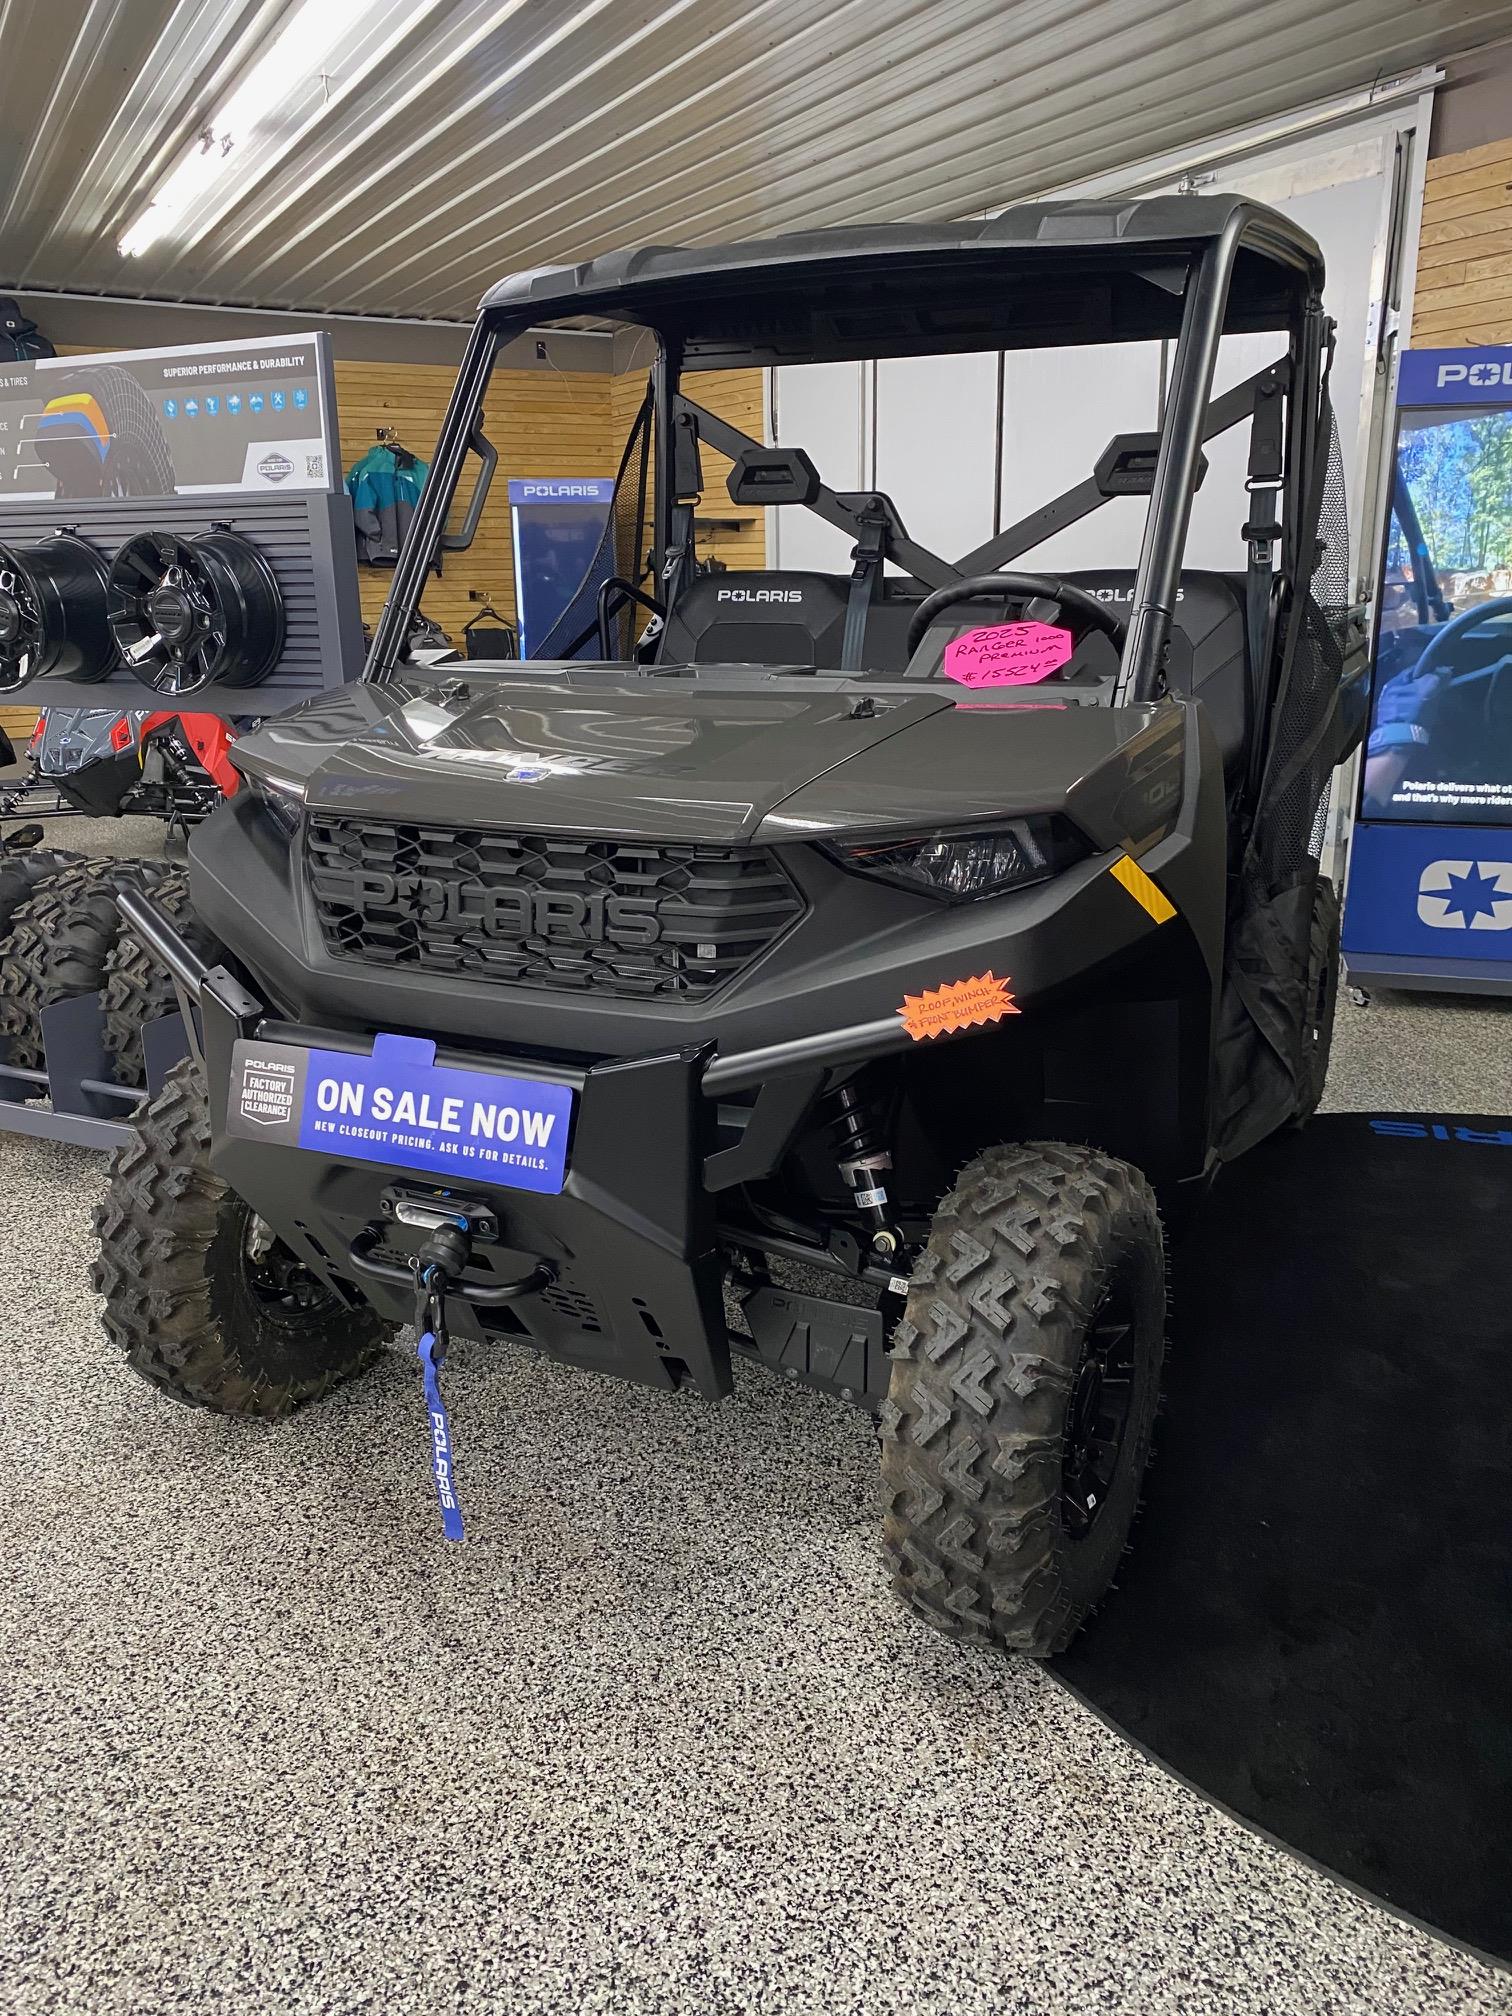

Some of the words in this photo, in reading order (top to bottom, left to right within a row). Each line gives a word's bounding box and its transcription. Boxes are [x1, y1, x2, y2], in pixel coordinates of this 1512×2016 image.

[163, 365, 198, 377] SUPERIOR
[199, 361, 252, 374] PERFORMANCE
[253, 361, 259, 370] &
[260, 356, 305, 369] DURABILITY
[10, 376, 28, 386] TIRES
[523, 485, 600, 497] POLARIS
[717, 589, 803, 603] POLARIS
[972, 624, 1037, 642] 2025
[955, 639, 1028, 657] RANGER
[979, 644, 1063, 663] PREMIUM
[1402, 780, 1436, 791] Polaris
[1436, 781, 1475, 792] delivers
[1475, 783, 1501, 793] what
[1392, 793, 1411, 802] and
[1412, 793, 1439, 803] that's
[1439, 794, 1460, 806] why
[1460, 796, 1486, 804] more
[353, 869, 664, 945] POLARIS
[919, 1011, 951, 1028] FRONT
[953, 995, 1003, 1018] BUMPER
[245, 1059, 296, 1074] POLARIS
[249, 1077, 287, 1093] FACTORY
[241, 1088, 293, 1106] AUTHORIZED
[244, 1100, 288, 1117] CLEARANCE
[316, 1078, 365, 1117] ON
[371, 1087, 464, 1133] SALE
[470, 1102, 556, 1148] NOW
[314, 1120, 336, 1133] NEW
[339, 1124, 388, 1142] CLOSEOUT
[391, 1133, 435, 1151] PRICING.
[439, 1141, 458, 1155] ASK
[462, 1145, 476, 1158] US
[479, 1148, 499, 1162] FOR
[502, 1152, 549, 1171] DETAILS.
[431, 1411, 456, 1510] POLARIS
